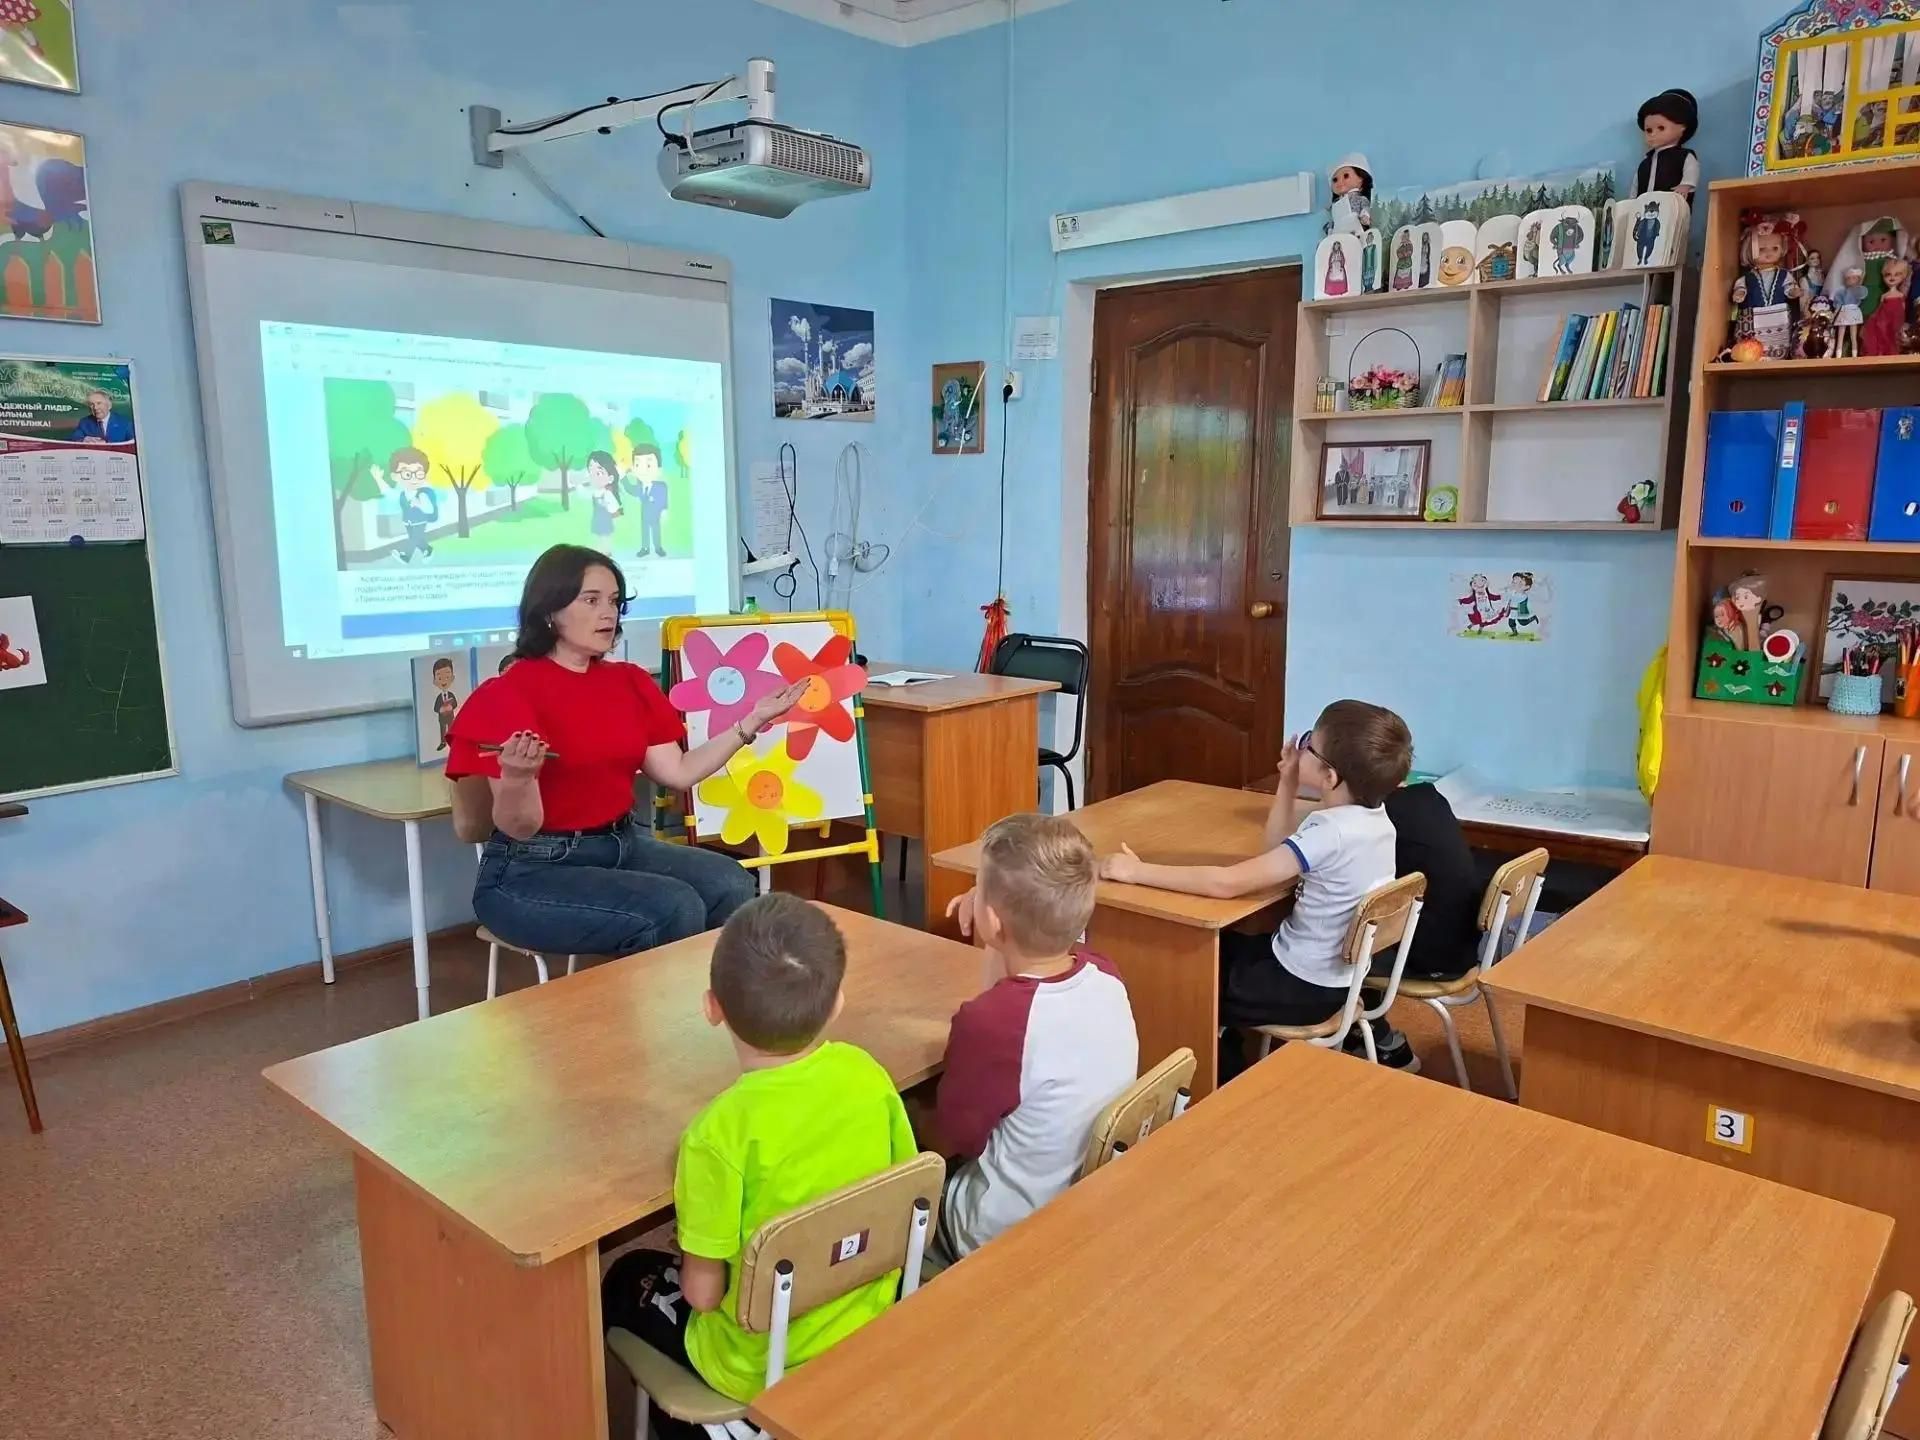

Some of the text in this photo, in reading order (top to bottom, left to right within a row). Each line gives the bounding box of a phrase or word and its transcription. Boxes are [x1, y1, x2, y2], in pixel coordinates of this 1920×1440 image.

[215, 195, 260, 208] Panasonic
[43, 404, 73, 412] ЛИДЕР
[1718, 1114, 1735, 1138] 3
[845, 1240, 855, 1255] 2
